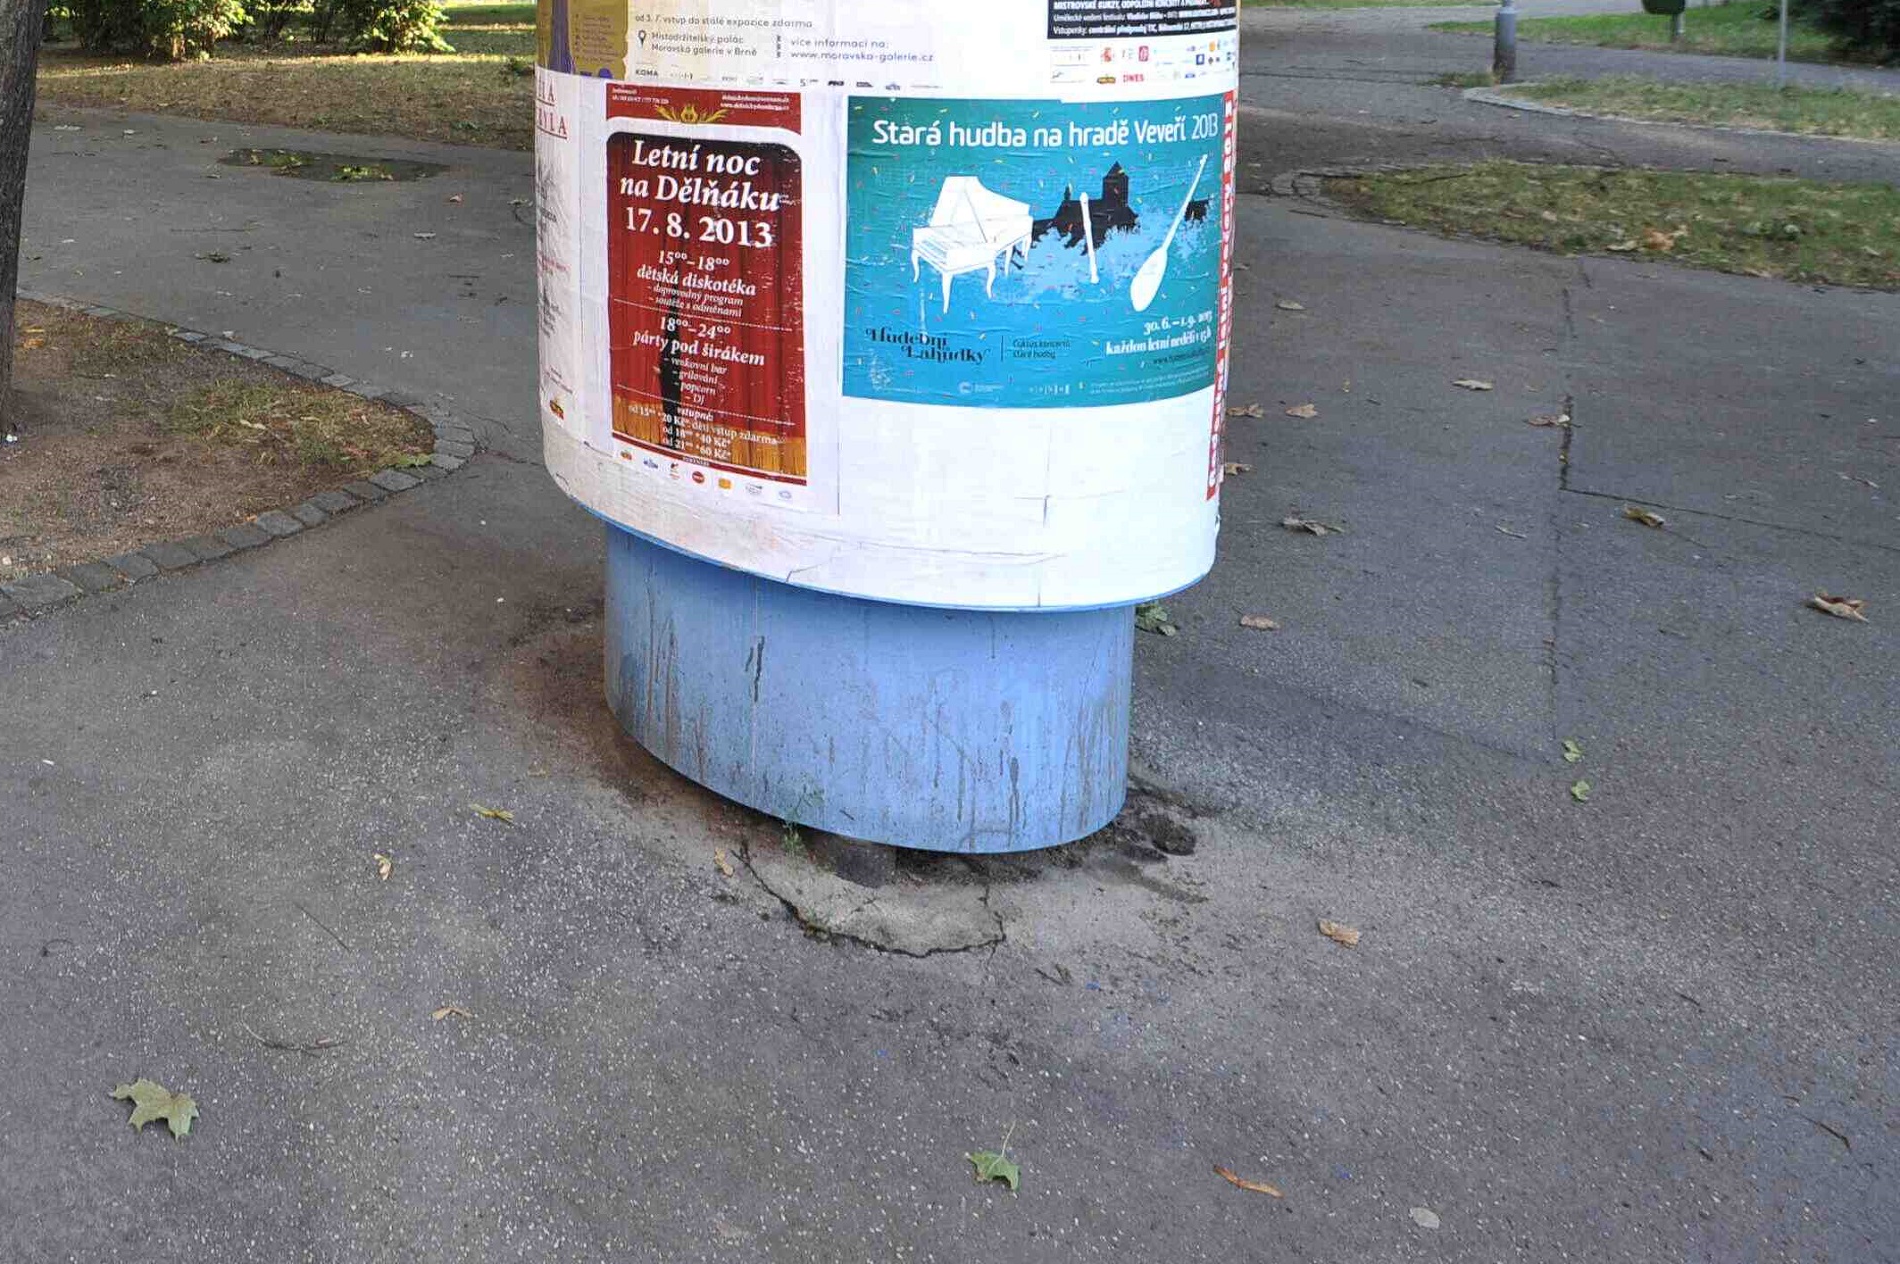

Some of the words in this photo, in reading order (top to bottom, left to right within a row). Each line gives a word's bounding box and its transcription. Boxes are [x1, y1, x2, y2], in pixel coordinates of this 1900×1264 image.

[663, 16, 686, 25] vstup
[727, 18, 769, 28] expozice
[873, 119, 942, 147] Stará
[950, 120, 1027, 147] hudba
[1034, 127, 1062, 147] na
[1069, 118, 1129, 146] hradě
[1134, 113, 1187, 142] Veveří
[1191, 112, 1219, 140] 2013
[632, 140, 700, 169] Letní
[707, 154, 761, 176] noc
[620, 178, 648, 198] na
[655, 175, 781, 212] Dělňáku
[626, 207, 659, 235] 17.
[667, 212, 690, 239] 8.
[699, 216, 774, 248] 2013
[637, 264, 679, 285] dětská
[682, 272, 756, 296] diskotéka
[704, 292, 744, 306] program
[633, 330, 668, 352] párty
[671, 339, 699, 355] pod
[702, 343, 765, 366] širákem
[680, 382, 716, 396] popcorn
[711, 426, 737, 439] vstup
[739, 430, 778, 445] zdarma
